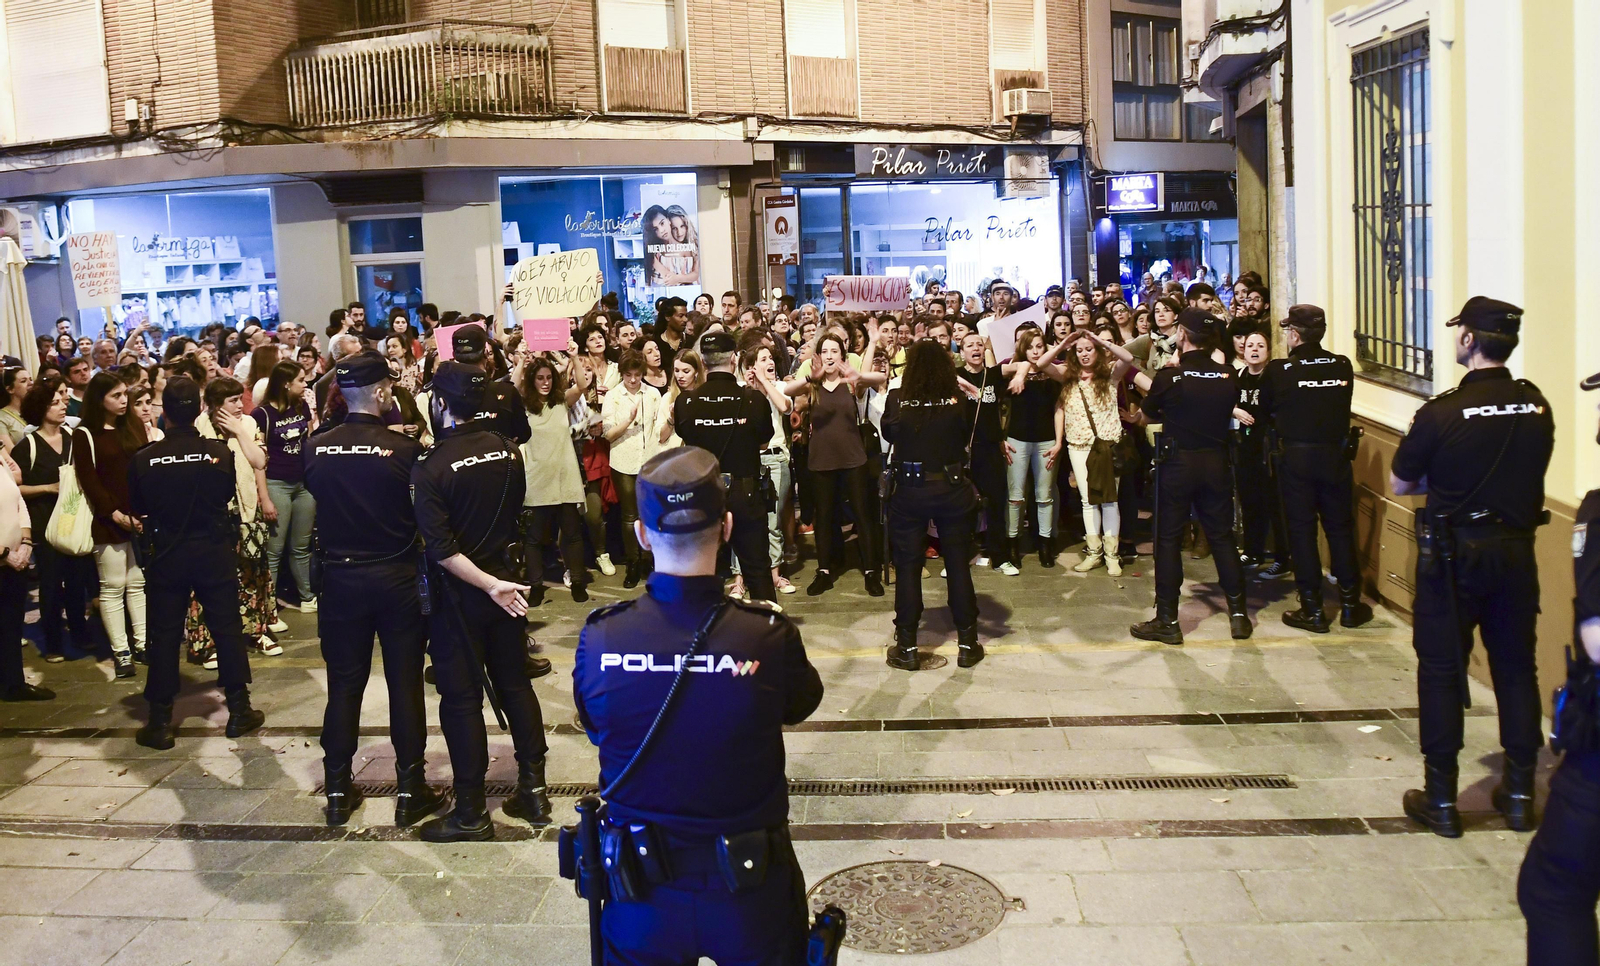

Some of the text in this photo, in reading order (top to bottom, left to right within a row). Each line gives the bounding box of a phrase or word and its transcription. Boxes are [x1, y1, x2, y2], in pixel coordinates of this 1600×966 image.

[871, 147, 927, 175] Pilar
[1111, 176, 1154, 191] MARTA
[1171, 201, 1200, 213] MARTA
[925, 215, 1037, 243] Pilar Prieto
[69, 233, 114, 248] NO HAY
[647, 244, 665, 254] NUEVA
[513, 251, 591, 282] NO ES ABUSO
[515, 276, 599, 311] ES VIOLACIÓN
[828, 276, 909, 306] ES VIOLACION
[1183, 371, 1223, 379] POLICIA
[1298, 379, 1342, 388] POLICIA
[1462, 402, 1538, 420] POLICIA
[315, 445, 383, 456] POLICIA
[150, 453, 213, 467] POLICIA
[451, 450, 510, 472] POLICIA
[667, 492, 694, 503] CNP
[600, 653, 739, 673] POLICIA
